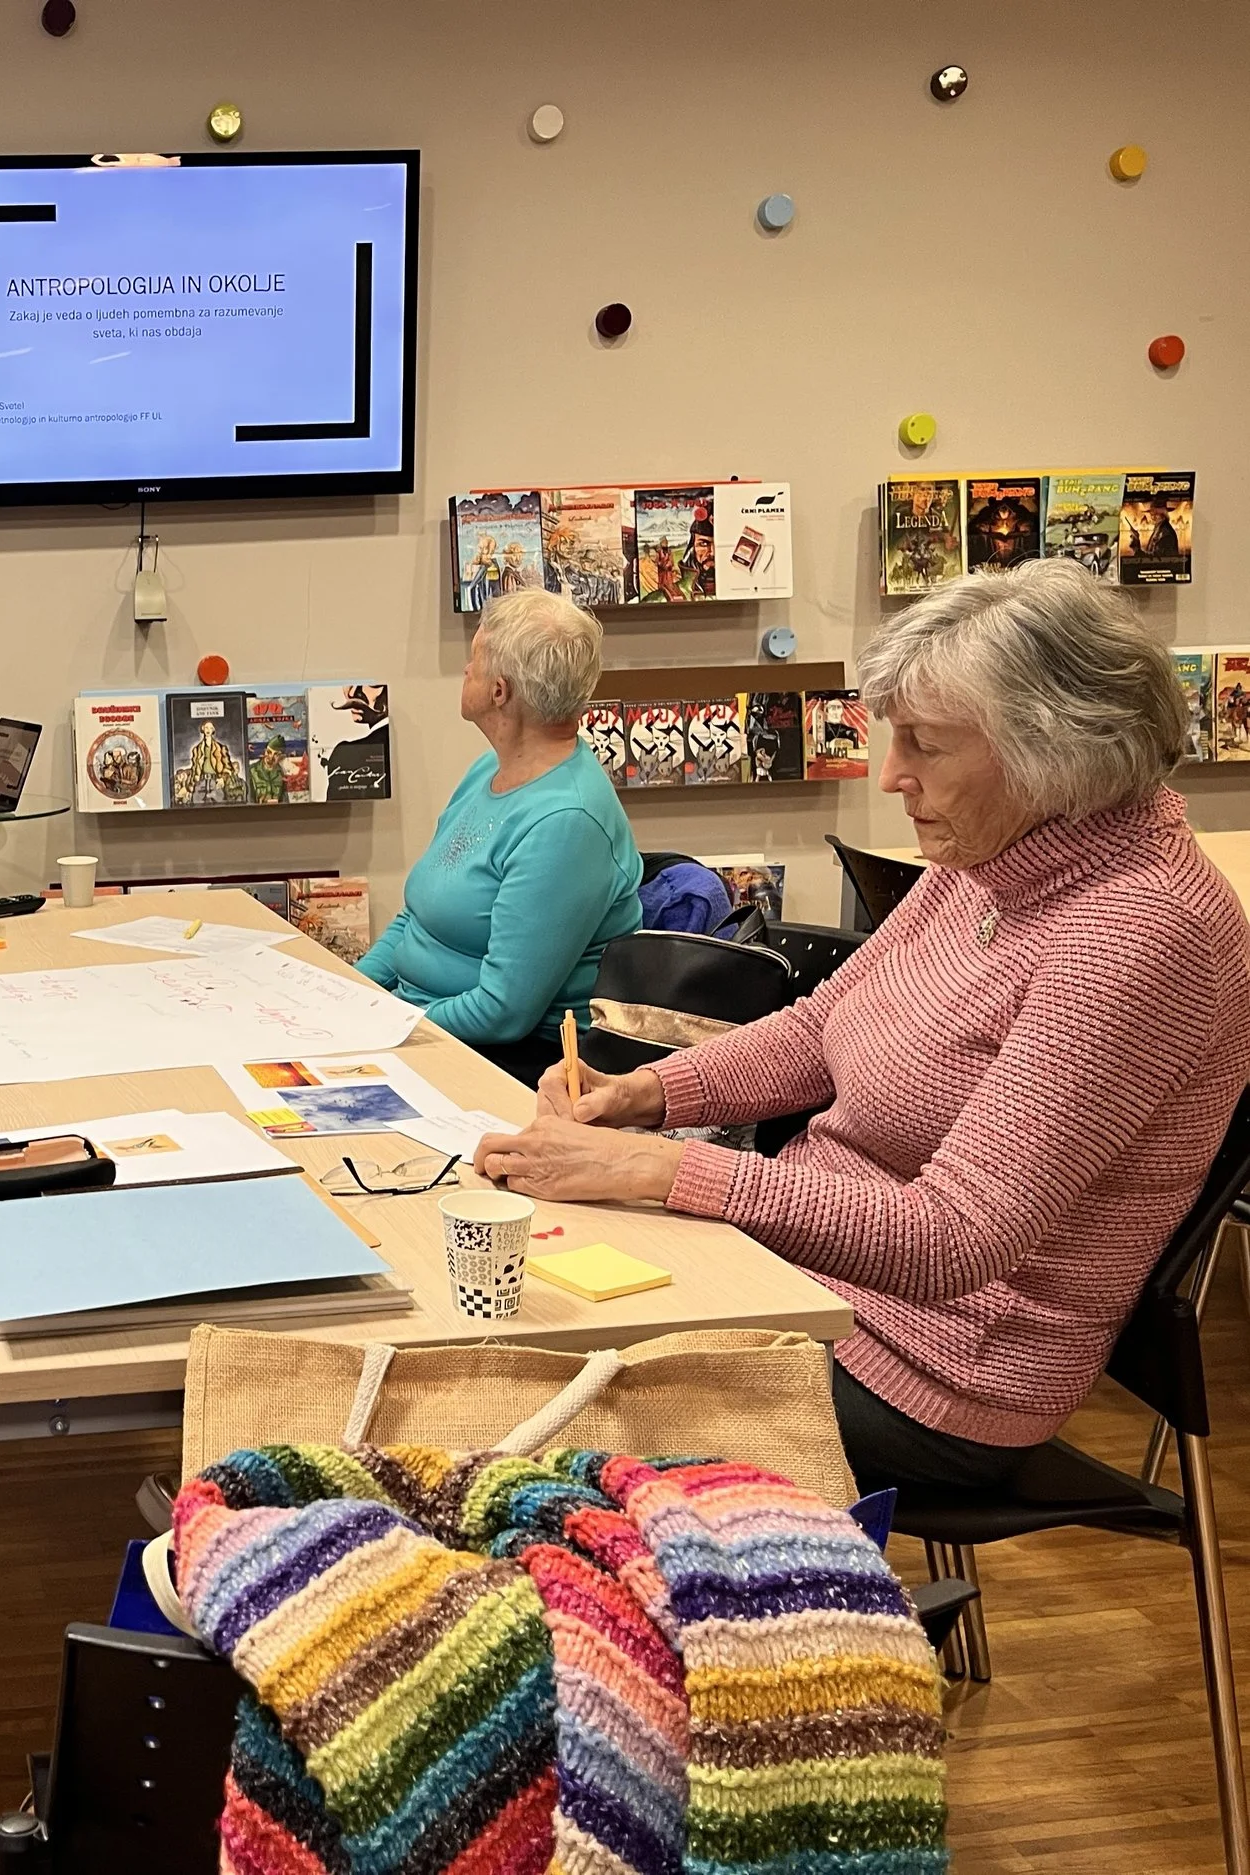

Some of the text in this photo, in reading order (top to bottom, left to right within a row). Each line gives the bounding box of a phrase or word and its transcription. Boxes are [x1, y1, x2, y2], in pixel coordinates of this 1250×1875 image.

[6, 273, 286, 297] ANTROPOLOGIJA IN OKOLJE
[9, 305, 285, 323] Zakaj je veda o ljudeh pomembna za razumevanje
[92, 326, 202, 341] sveta, ki nas obdaja
[0, 401, 25, 411] Svetel
[38, 415, 47, 423] in
[140, 412, 150, 421] FF
[151, 411, 163, 421] UL
[626, 704, 680, 726] MAUS
[684, 699, 738, 722] MAUS
